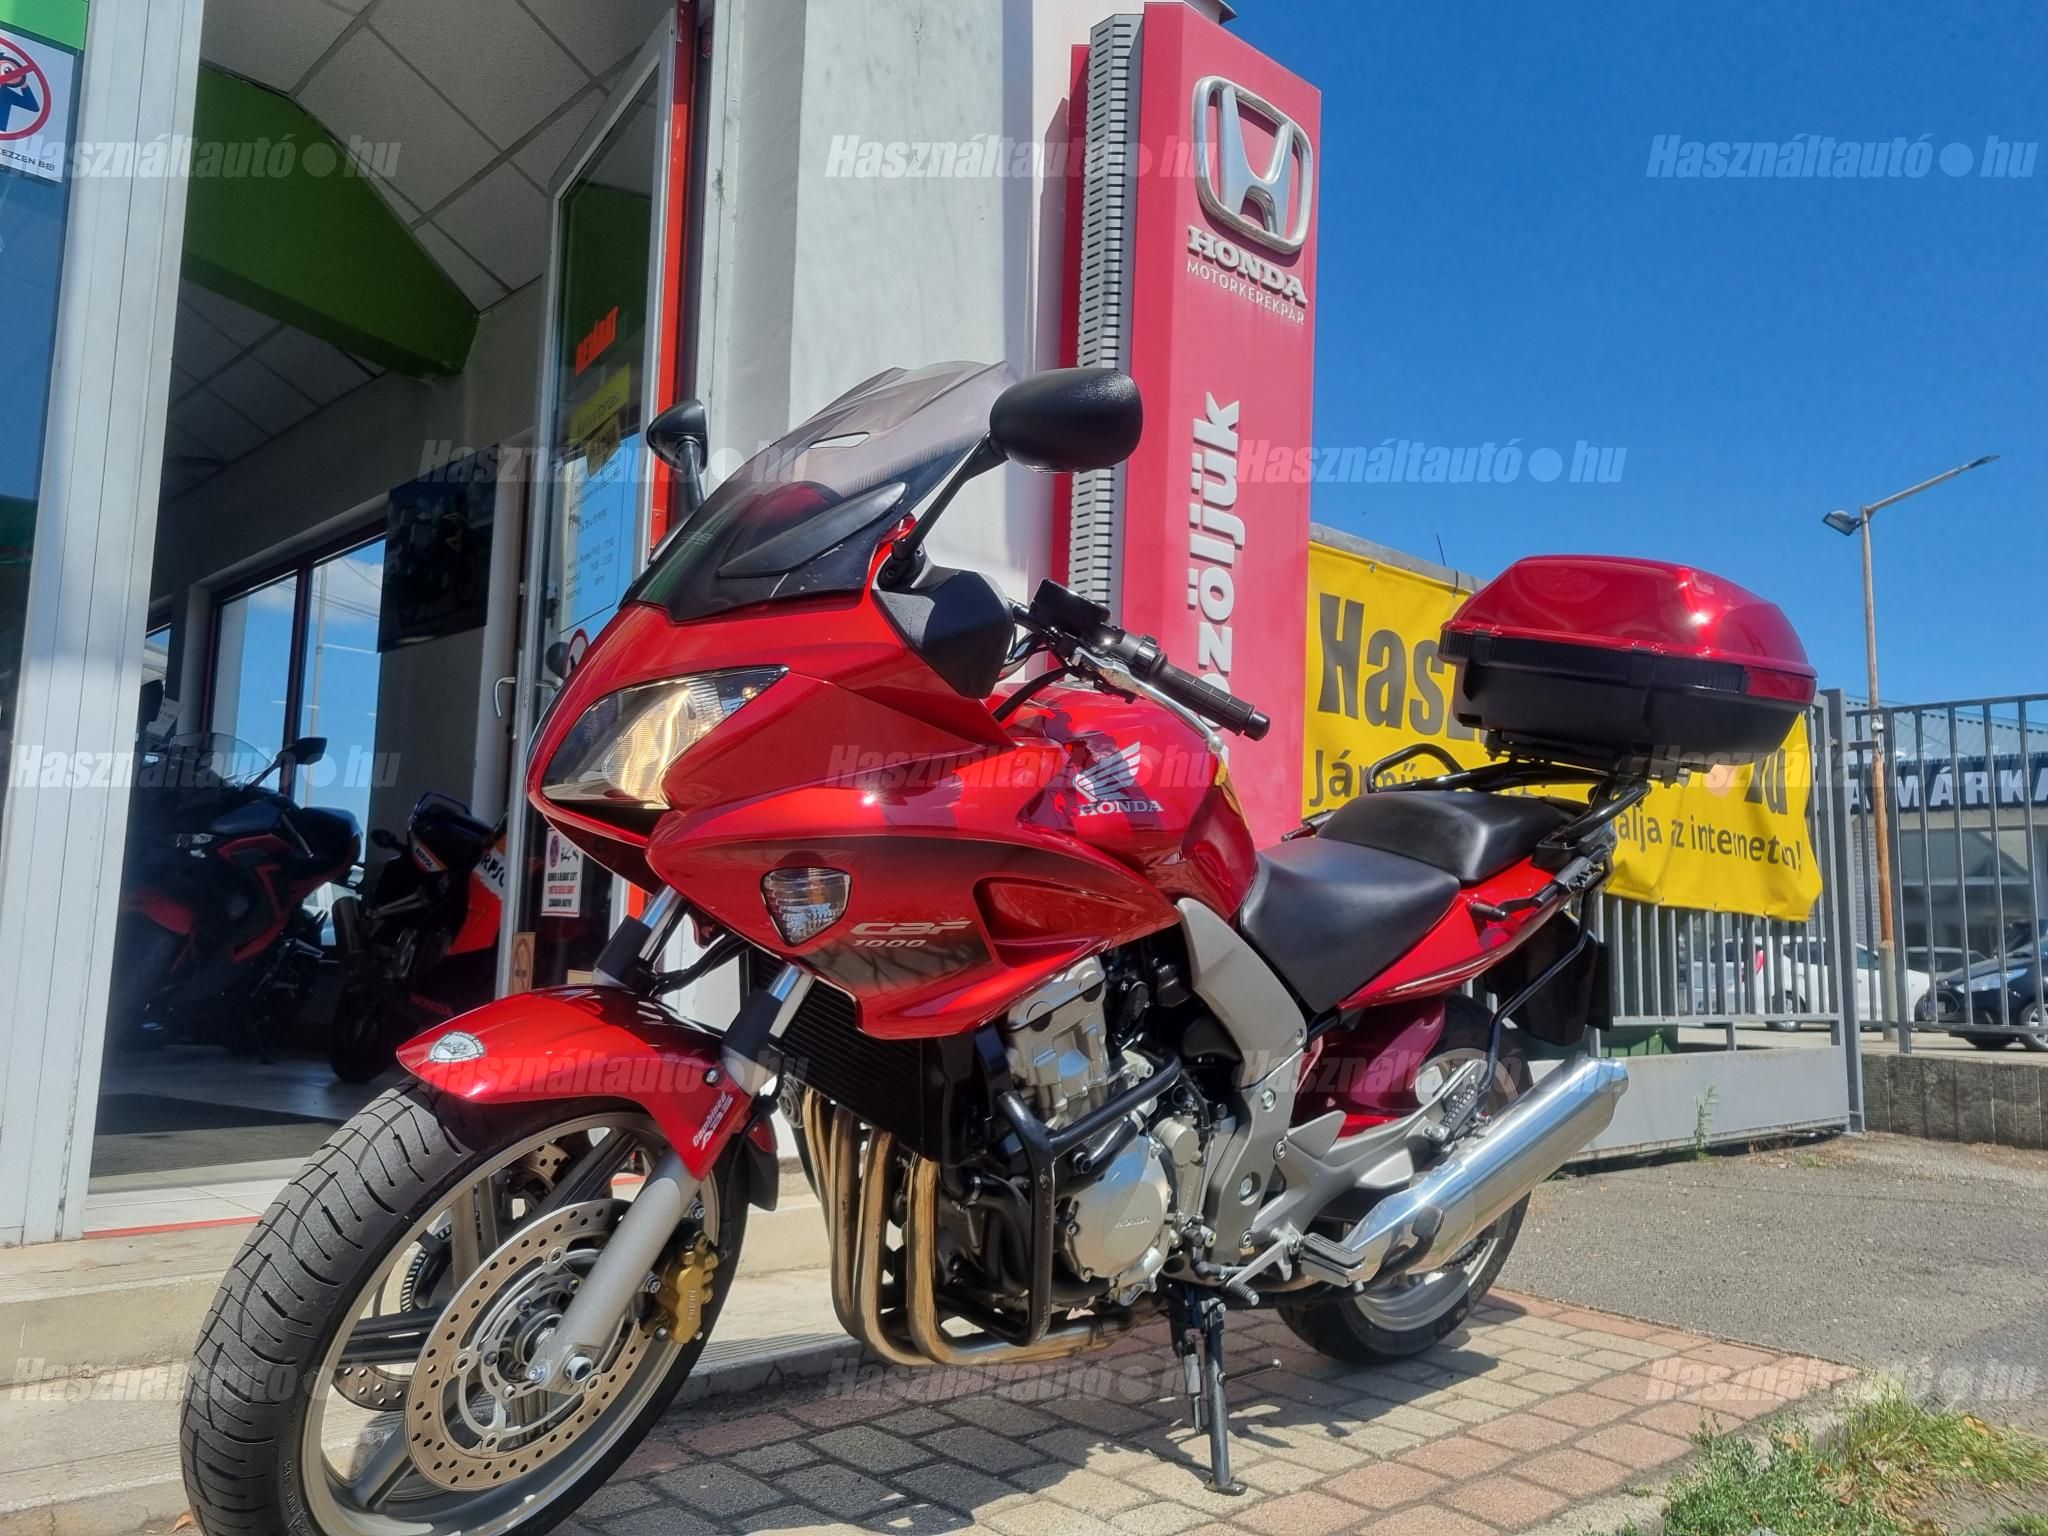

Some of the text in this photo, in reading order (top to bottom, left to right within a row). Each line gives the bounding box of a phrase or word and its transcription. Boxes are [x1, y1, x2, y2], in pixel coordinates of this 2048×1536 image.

[0, 148, 36, 166] EZZEN
[1187, 225, 1308, 308] HONDA
[1187, 258, 1305, 325] MOTORKERÉKPÁR
[1079, 799, 1164, 816] HONDA
[1612, 803, 1663, 853] alja
[850, 920, 972, 936] CBF
[854, 939, 927, 948] 1000
[692, 1090, 727, 1148] Combined
